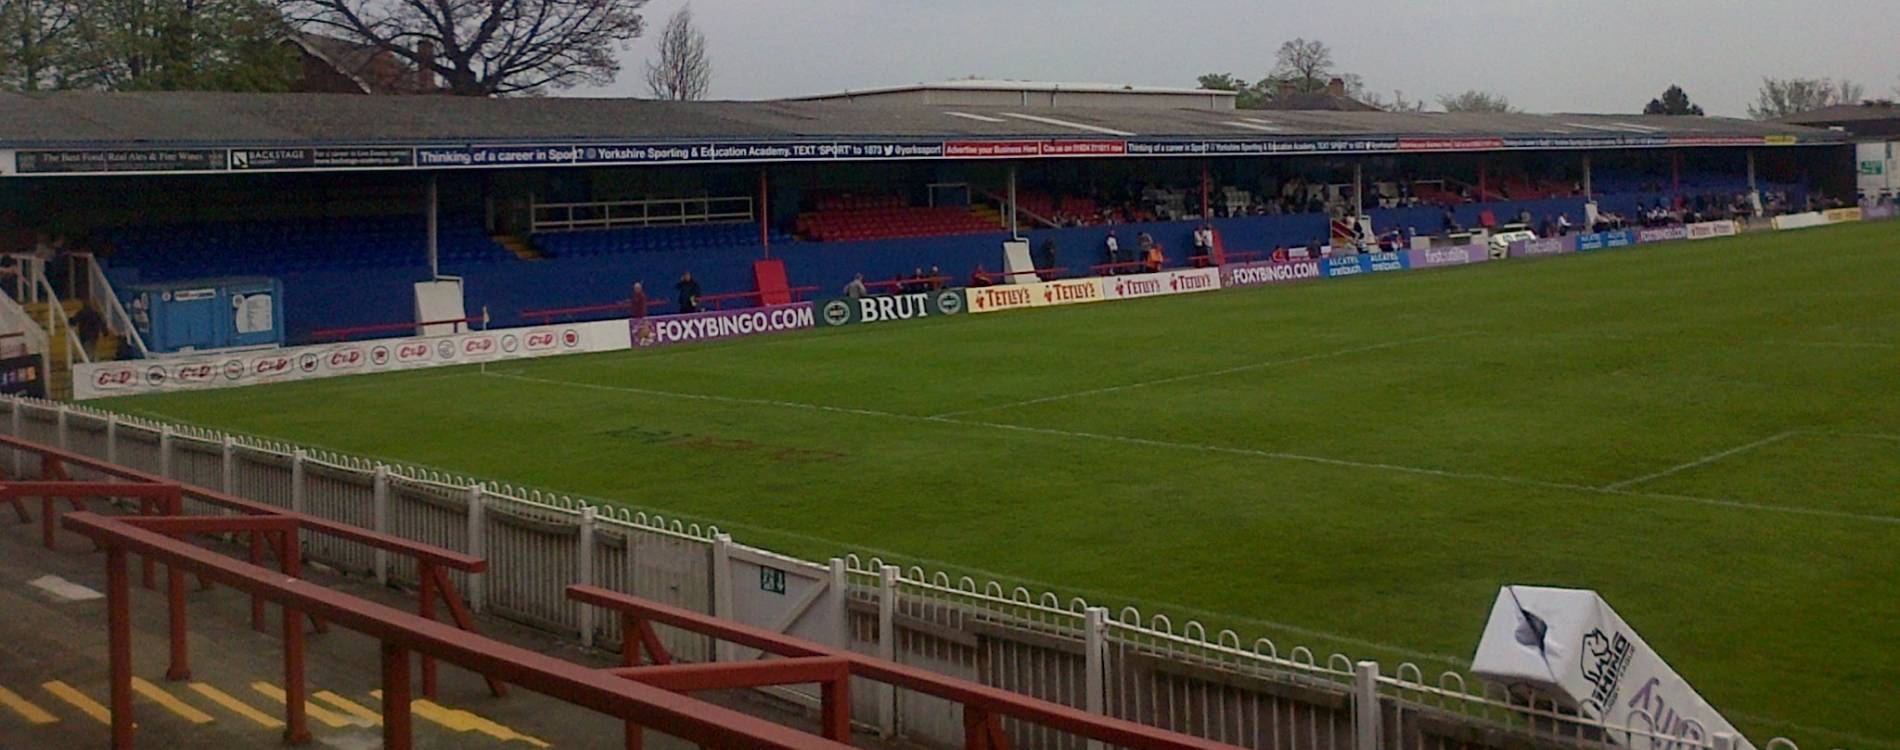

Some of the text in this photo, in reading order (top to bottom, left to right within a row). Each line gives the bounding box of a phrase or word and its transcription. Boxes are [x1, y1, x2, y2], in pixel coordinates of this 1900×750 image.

[250, 150, 304, 160] BACKSTAGE
[420, 151, 470, 164] Thinking
[473, 150, 487, 161] of
[488, 152, 496, 161] a
[497, 151, 533, 161] career
[536, 149, 547, 160] in
[599, 148, 645, 159] Yorkshire
[647, 147, 688, 160] Sporting
[691, 147, 698, 158] &
[701, 146, 747, 157] Education
[793, 145, 815, 155] TEXT
[853, 145, 862, 154] to
[946, 145, 977, 154] Advertise
[1329, 255, 1359, 266] ALCATEL
[1233, 261, 1319, 284] FOXYBINGO.COM
[859, 293, 928, 322] BRUT
[656, 307, 815, 342] FOXYBINGO.COM
